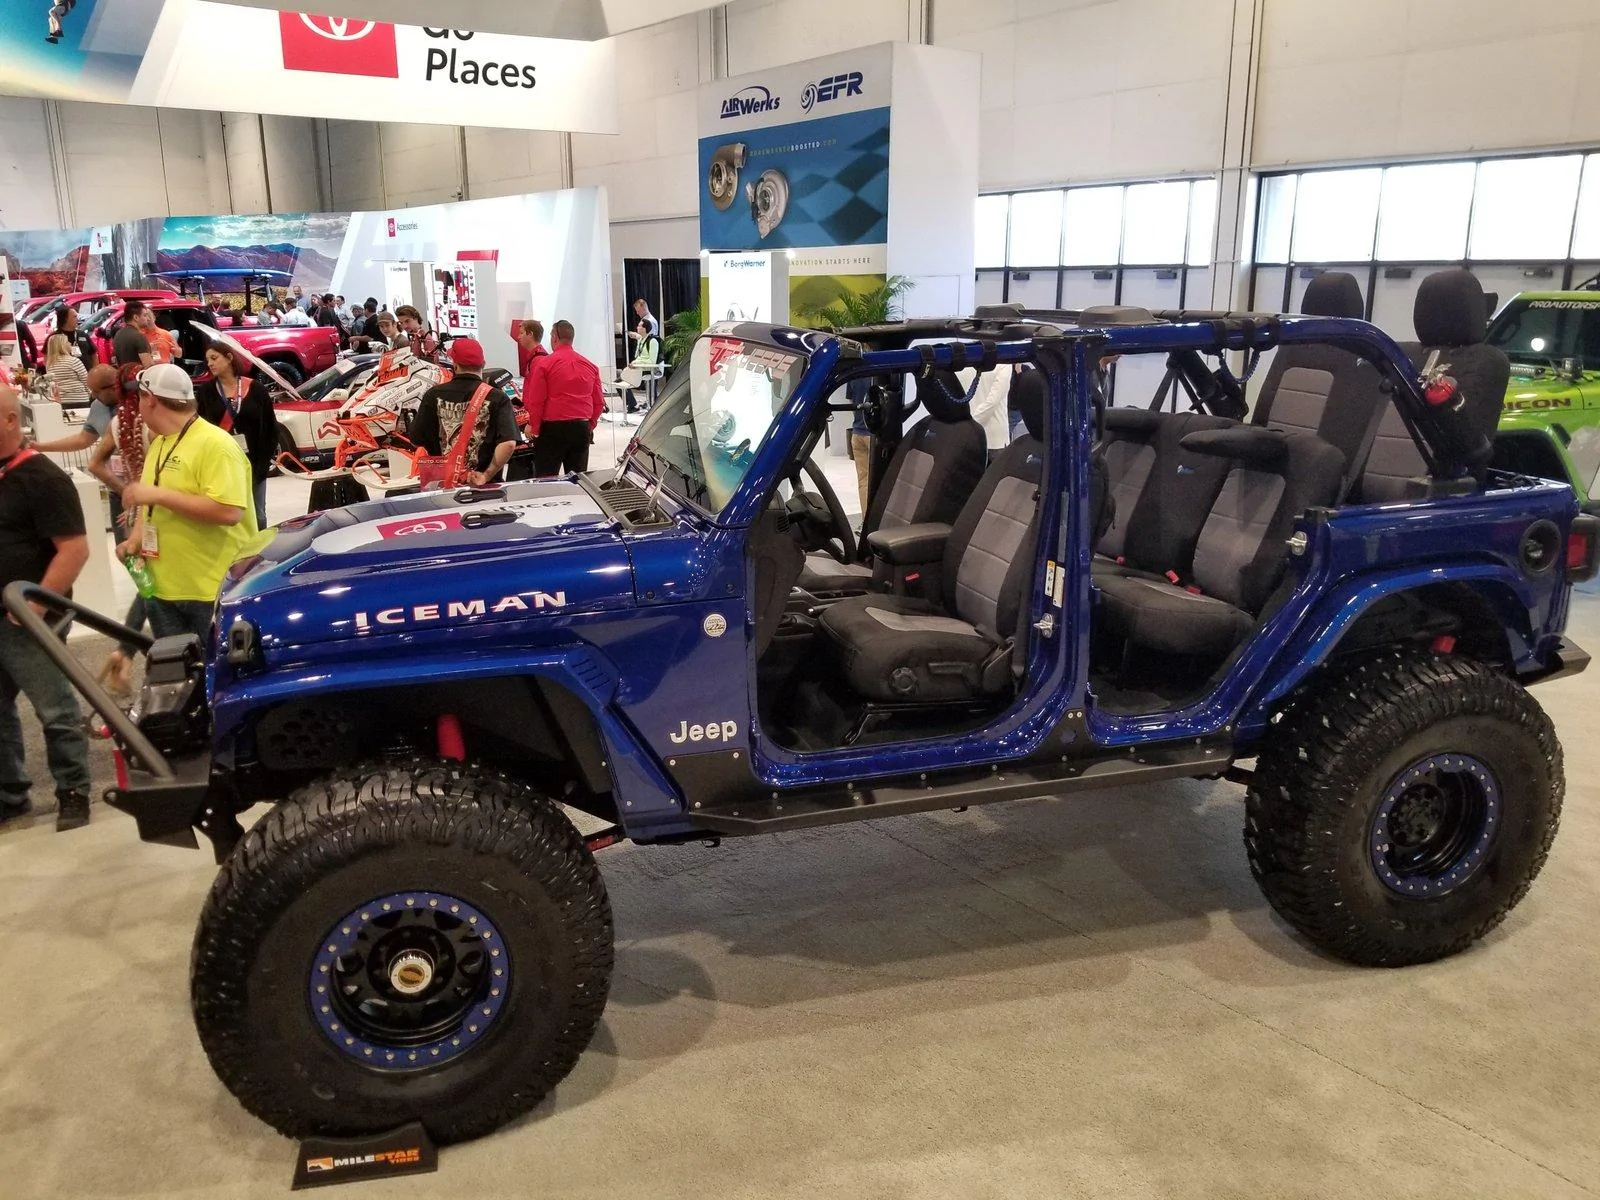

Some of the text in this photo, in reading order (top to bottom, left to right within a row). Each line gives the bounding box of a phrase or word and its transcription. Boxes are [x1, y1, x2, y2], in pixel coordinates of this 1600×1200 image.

[426, 48, 536, 89] Places
[816, 71, 864, 103] EFR
[731, 260, 766, 269] BorgWarner
[354, 590, 567, 627] ICEMAN
[669, 719, 738, 744] Jeep
[334, 1147, 420, 1166] MILESTAR
